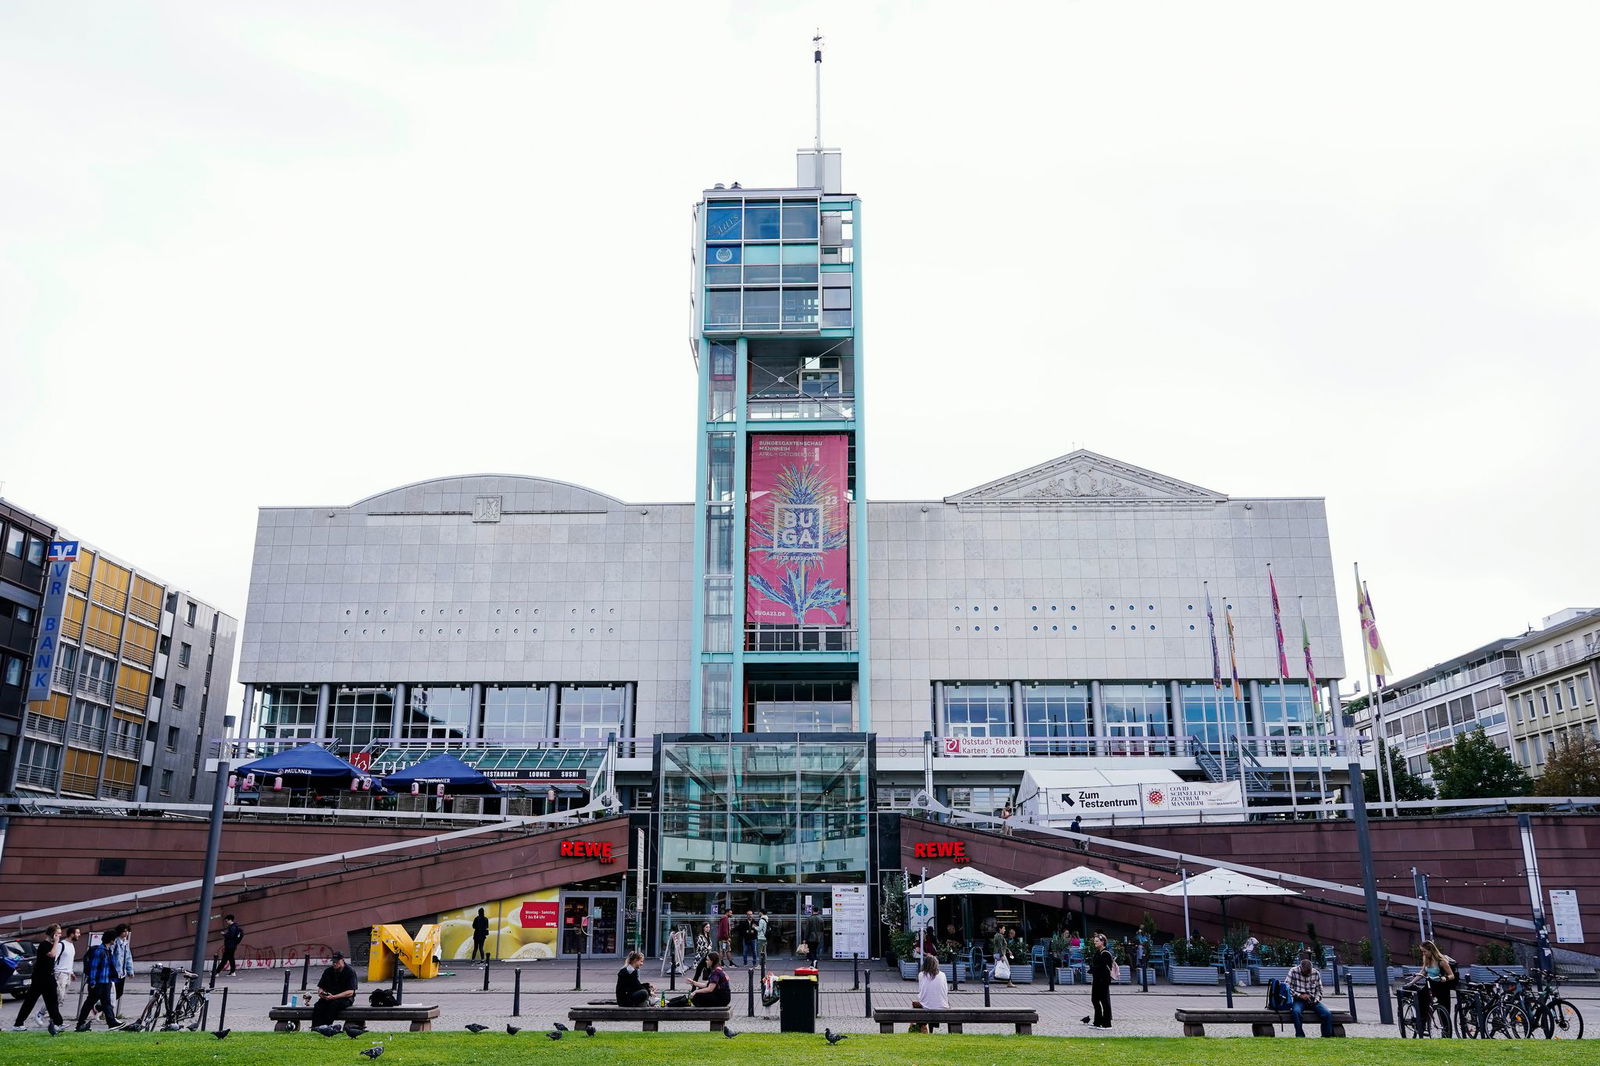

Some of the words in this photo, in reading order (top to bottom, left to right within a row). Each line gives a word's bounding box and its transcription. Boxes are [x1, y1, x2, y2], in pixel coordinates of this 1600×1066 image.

[784, 511, 813, 528] BU
[782, 528, 814, 545] GA
[51, 564, 67, 595] VR
[35, 618, 56, 687] BANK
[995, 738, 1022, 746] Theater
[1078, 791, 1100, 799] Zum
[1078, 798, 1138, 809] Testzentrum
[560, 841, 614, 857] REWE
[914, 841, 967, 858] REWE
